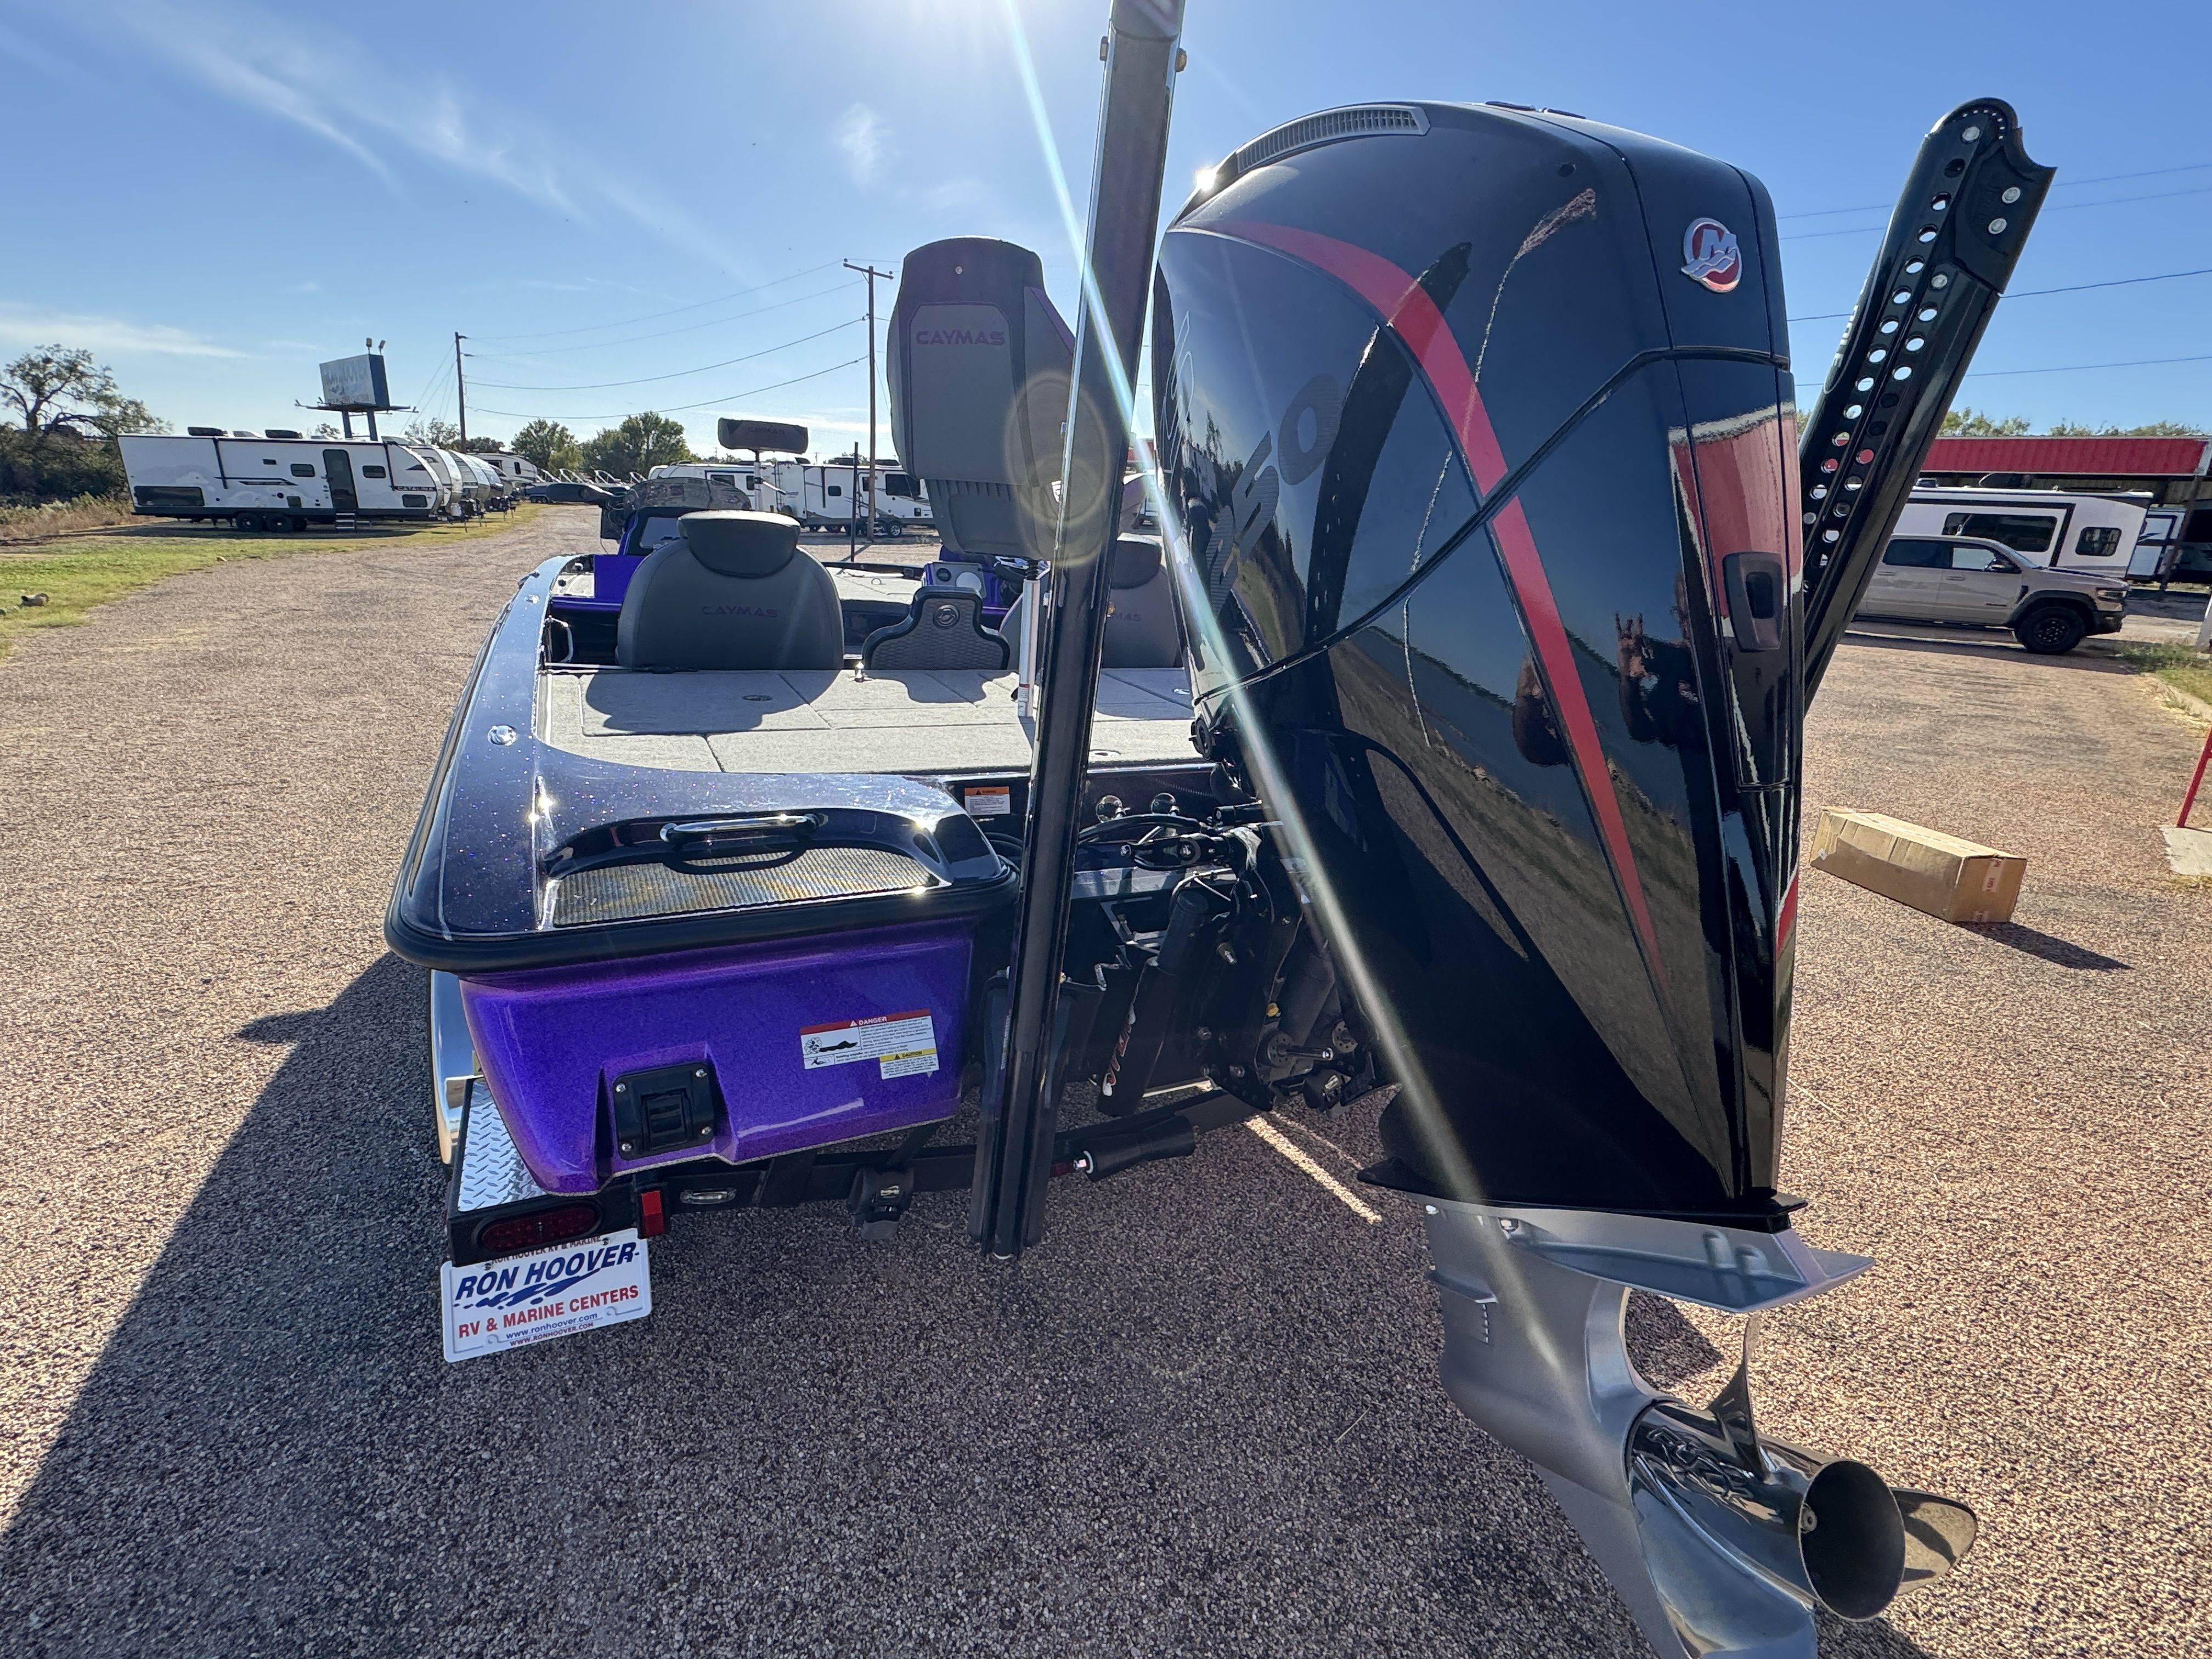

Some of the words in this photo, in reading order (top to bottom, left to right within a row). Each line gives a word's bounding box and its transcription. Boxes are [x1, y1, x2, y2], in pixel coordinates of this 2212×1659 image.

[916, 330, 1006, 346] CAYMAS
[702, 606, 777, 618] CAYMAS
[859, 1016, 887, 1025] DANGER
[455, 1266, 520, 1301] RON
[525, 1242, 637, 1286] HOOVER
[459, 1319, 480, 1339] RV
[486, 1318, 498, 1331] &
[503, 1302, 564, 1329] MARINE
[569, 1285, 639, 1312] CENTERS
[506, 1313, 598, 1340] www.ronhoover.com
[510, 1322, 594, 1347] WWW.RONHOOVER.COM
